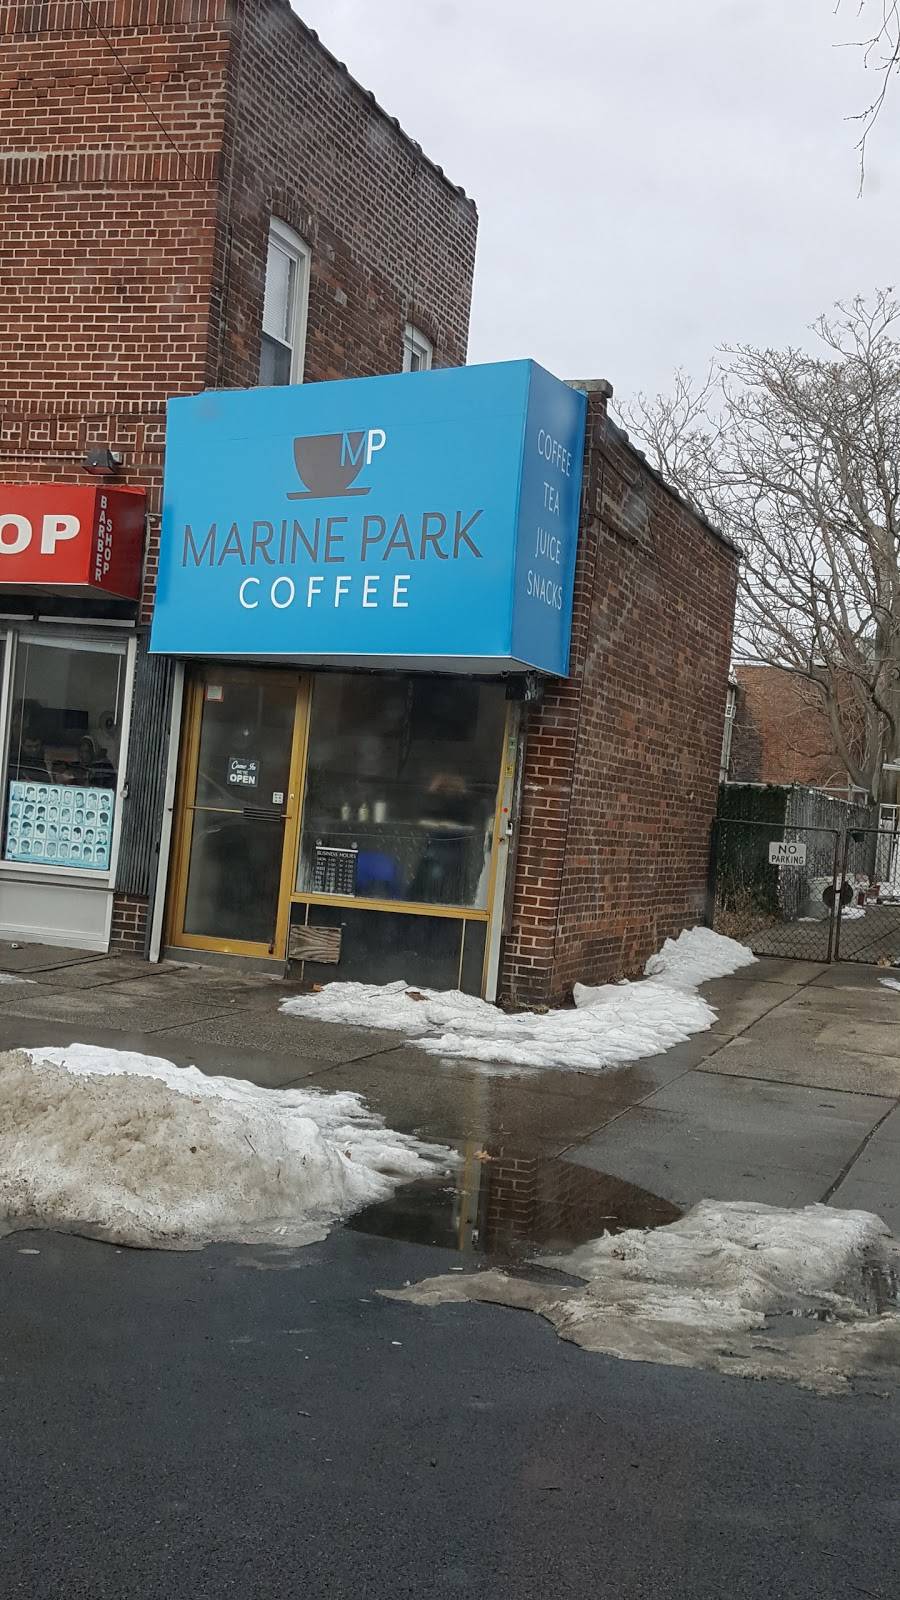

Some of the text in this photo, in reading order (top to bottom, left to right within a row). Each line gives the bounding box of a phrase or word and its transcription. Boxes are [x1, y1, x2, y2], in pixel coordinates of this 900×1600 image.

[341, 429, 386, 466] MP
[537, 429, 572, 477] COFFEE
[543, 482, 560, 516] TEA
[95, 495, 108, 582] BARBER
[103, 519, 113, 575] SHOP
[182, 509, 484, 567] MARINE PARK
[535, 527, 562, 565] JUICE
[239, 575, 411, 609] COFFEE
[527, 570, 563, 611] SNACKS
[230, 774, 255, 784] OPEN
[771, 854, 804, 865] PARKING
[778, 845, 797, 854] NO
